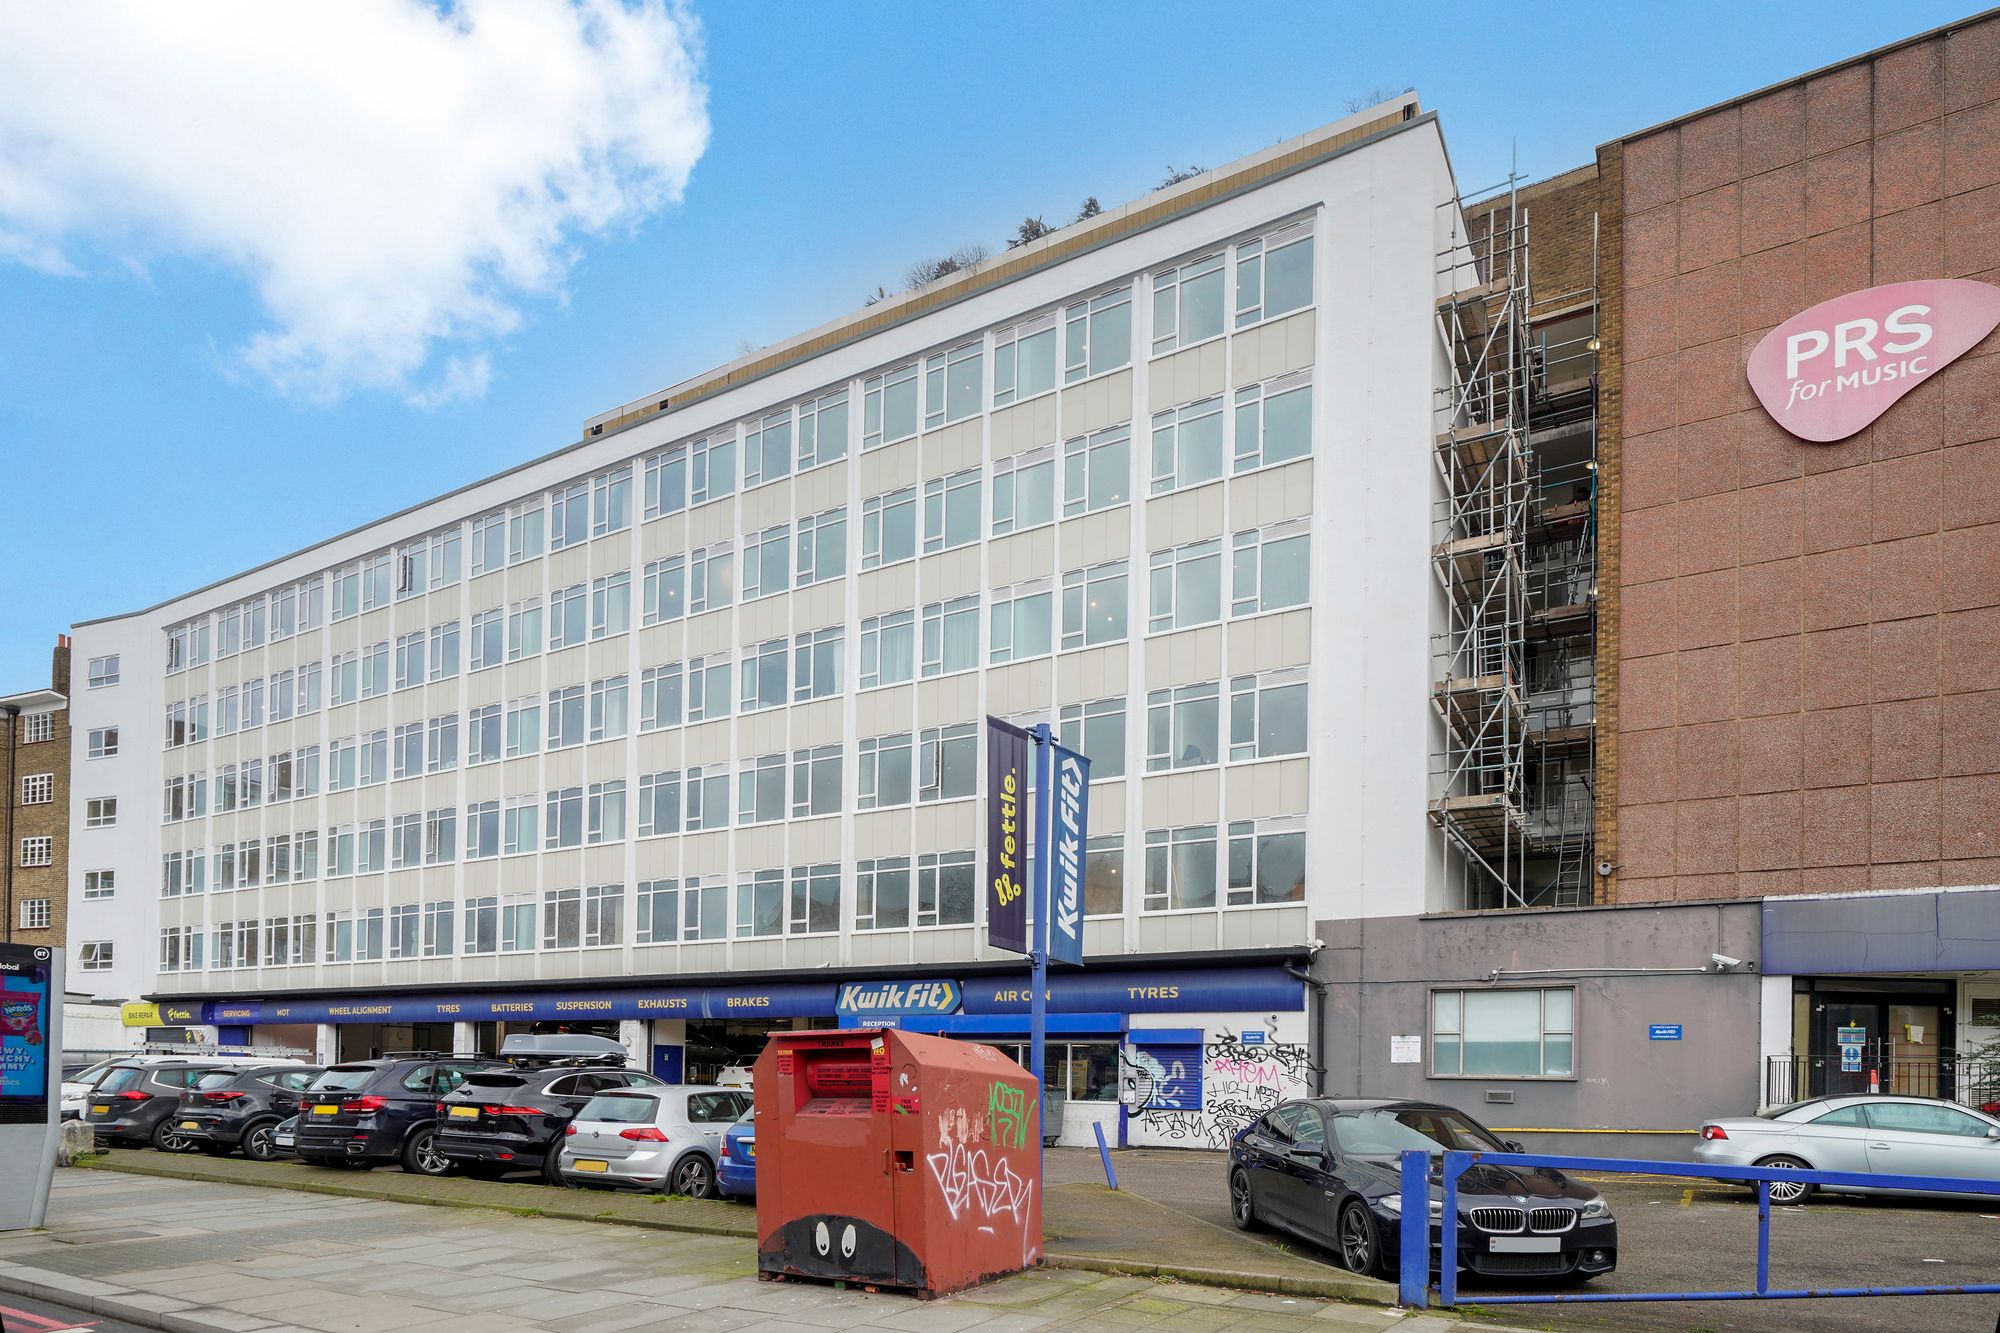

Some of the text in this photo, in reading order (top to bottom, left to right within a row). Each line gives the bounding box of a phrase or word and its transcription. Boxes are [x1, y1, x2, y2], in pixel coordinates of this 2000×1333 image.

[1786, 304, 1933, 379] PRS
[1785, 355, 1928, 410] for MUSIC
[1000, 767, 1016, 869] fettle.
[994, 990, 1051, 1001] AIR CN
[1128, 986, 1179, 999] TYRES
[491, 1003, 534, 1012] BATTERIES
[556, 1001, 612, 1010] SUSPENSION
[638, 998, 687, 1009] EXHAUSTS
[727, 997, 769, 1008] BRAKES
[328, 1006, 392, 1015] WHEEL ALIGNMENT
[436, 1004, 460, 1013] TYRES
